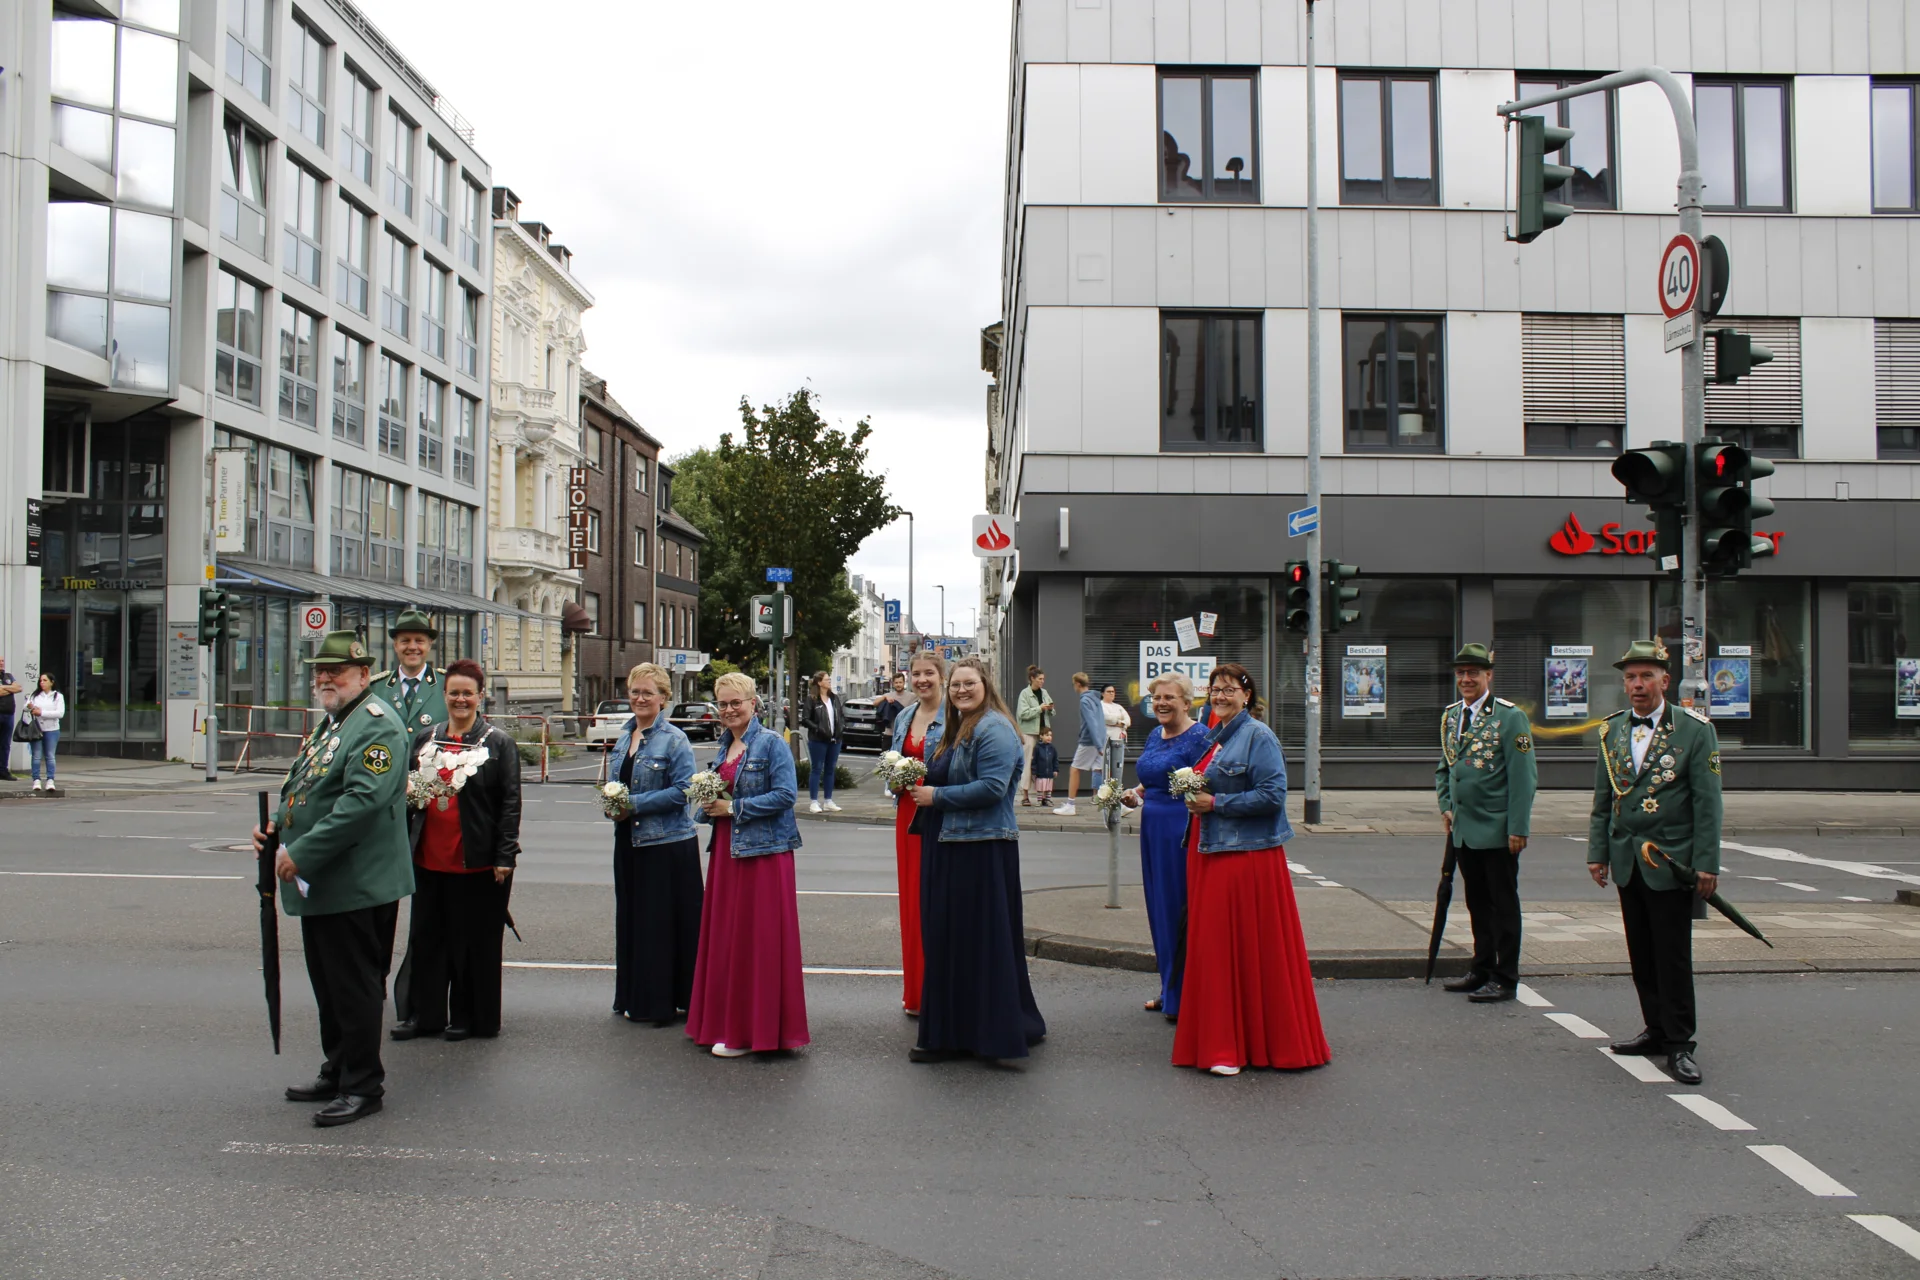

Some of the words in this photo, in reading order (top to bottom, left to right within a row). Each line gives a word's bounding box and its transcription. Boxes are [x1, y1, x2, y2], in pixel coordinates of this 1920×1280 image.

[1667, 255, 1690, 297] 40
[1667, 324, 1692, 342] Lärmschutz
[219, 466, 228, 521] TimePartner
[572, 469, 586, 568] HOTEL
[310, 614, 322, 623] 30
[886, 604, 896, 621] P
[1146, 646, 1171, 657] DAS
[1554, 647, 1592, 655] BestSparen
